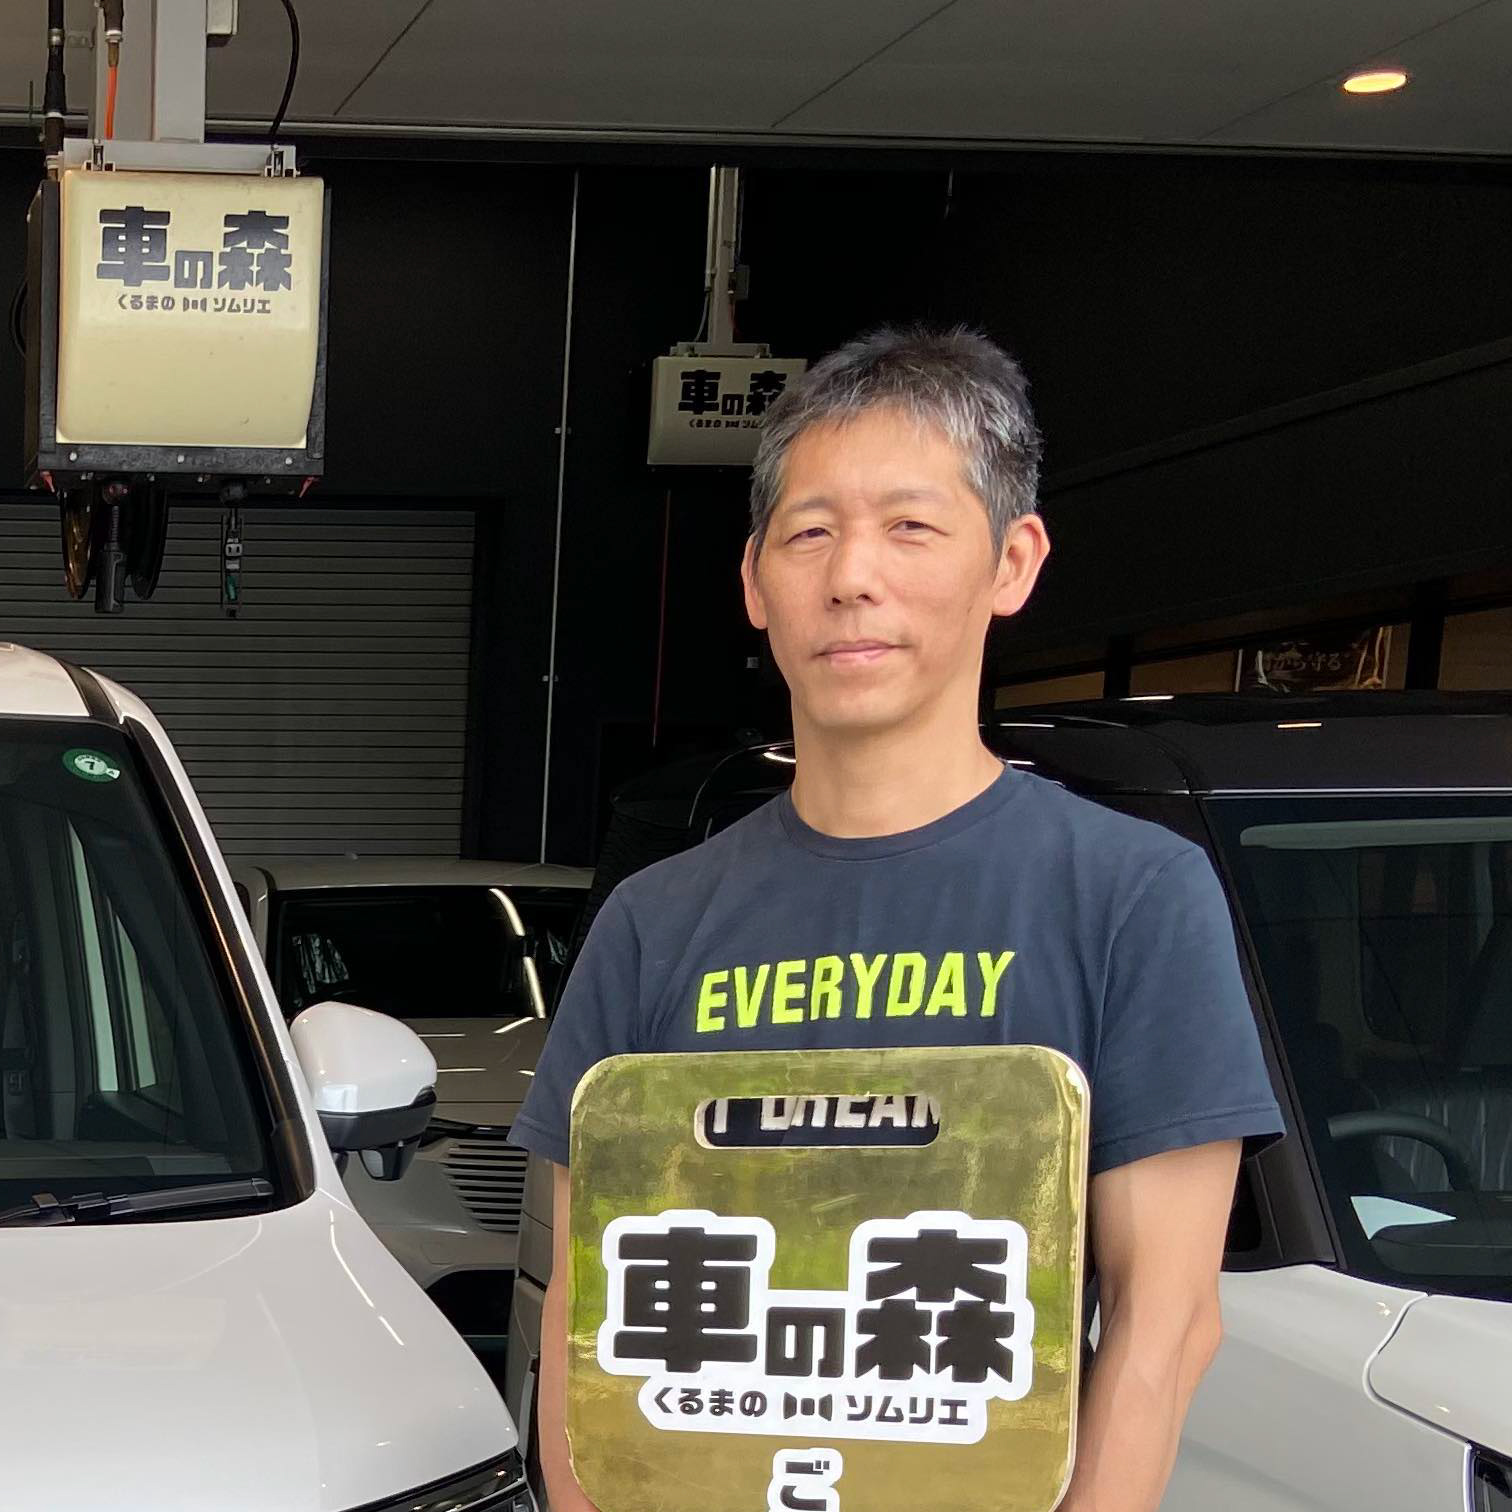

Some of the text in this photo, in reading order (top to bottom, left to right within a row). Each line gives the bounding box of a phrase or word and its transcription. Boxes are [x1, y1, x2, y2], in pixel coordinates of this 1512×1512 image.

[96, 206, 292, 291] 車の森
[116, 294, 271, 314] くるまの ソムリエ
[678, 370, 787, 415] 車の森
[696, 951, 1015, 1033] EVERYDAY
[614, 1227, 1014, 1383] 車の森
[653, 1386, 969, 1426] くるまの ソムリエ
